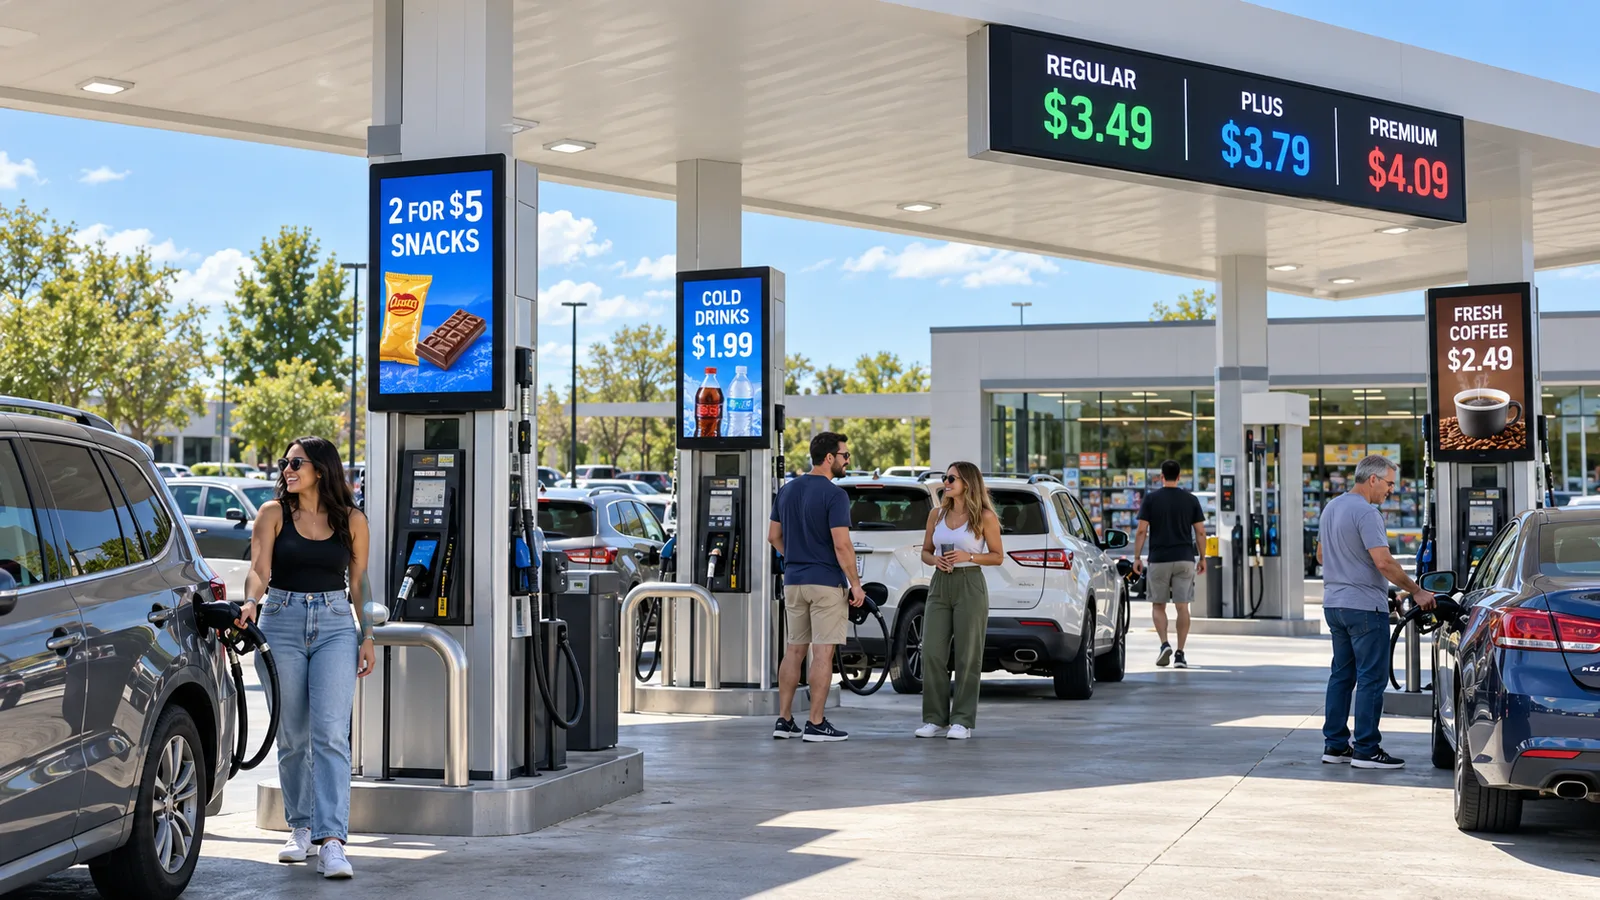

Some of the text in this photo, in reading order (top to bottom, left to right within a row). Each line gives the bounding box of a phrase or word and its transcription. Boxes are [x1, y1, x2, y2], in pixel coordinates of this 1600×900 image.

[1047, 54, 1137, 90] REGULAR
[1241, 91, 1283, 117] PLUS
[1043, 88, 1153, 150] $3.49
[1369, 116, 1438, 147] PREMIUM
[1221, 119, 1311, 177] $3.79
[1368, 146, 1448, 200] $4.09
[389, 189, 483, 225] 2 FOR $5
[391, 228, 480, 257] SNACKS
[702, 289, 742, 307] COLD
[695, 308, 750, 326] DRINKS
[1454, 304, 1502, 322] FRESH
[692, 331, 753, 360] $1.99
[1449, 322, 1509, 342] COFFEE
[1447, 345, 1513, 373] $2.49
